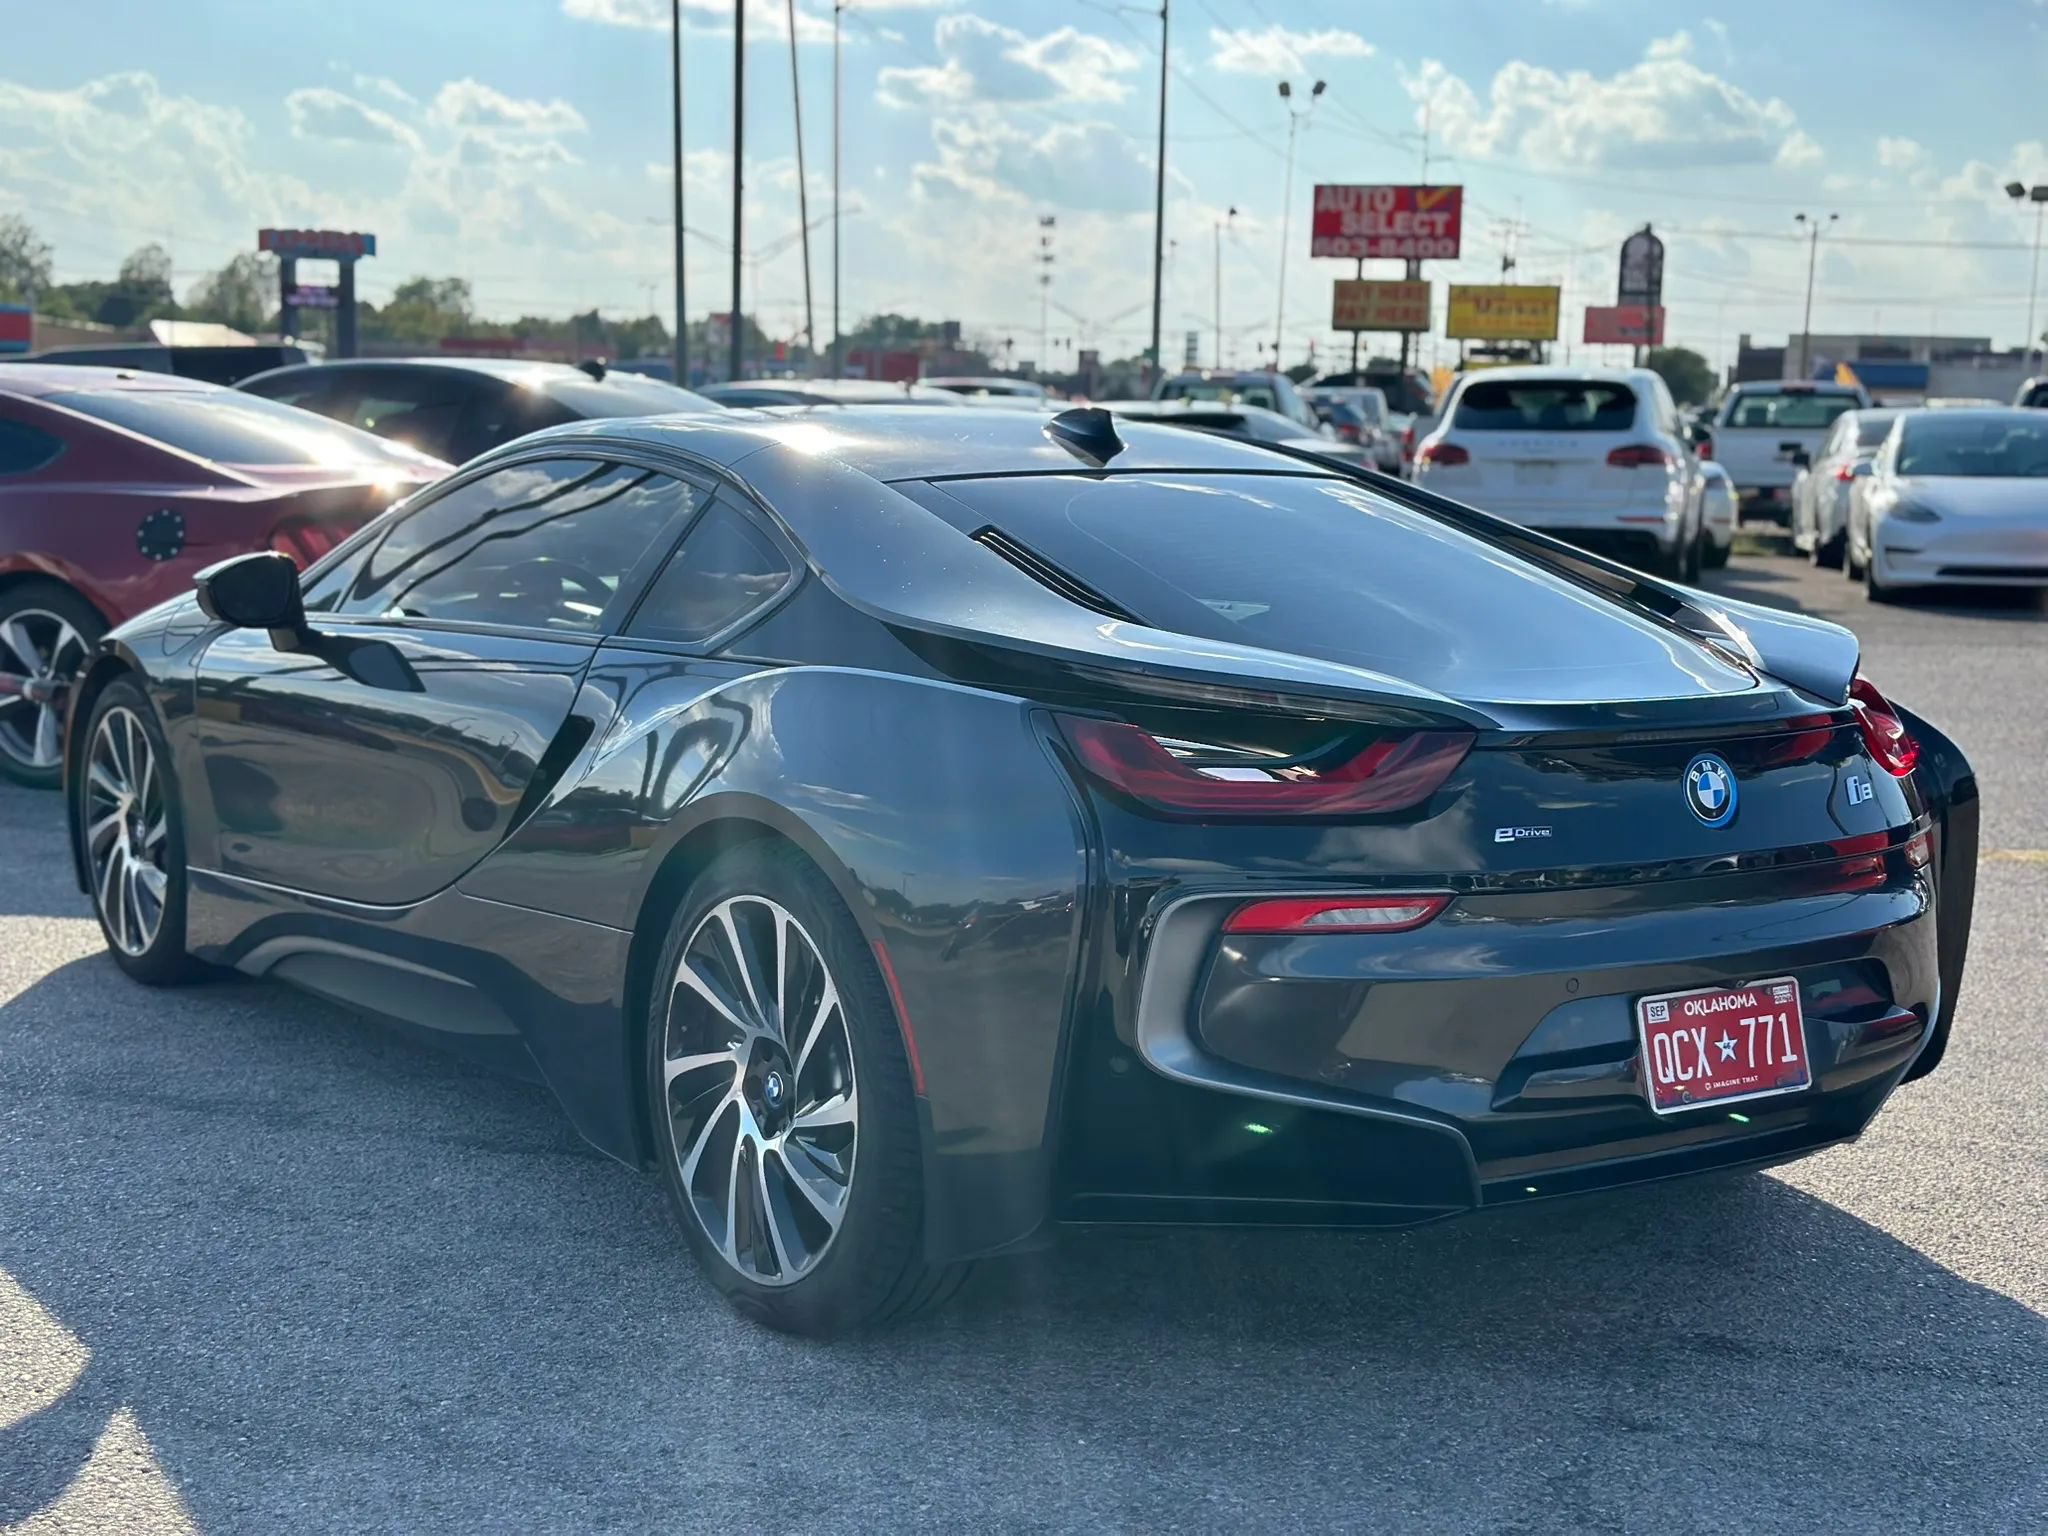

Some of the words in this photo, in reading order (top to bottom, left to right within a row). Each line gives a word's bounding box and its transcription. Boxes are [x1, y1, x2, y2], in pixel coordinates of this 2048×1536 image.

[1318, 186, 1395, 212] AUTO
[1341, 211, 1452, 236] SELECT
[1690, 762, 1727, 782] BMW
[1650, 1005, 1666, 1018] SEP
[1684, 992, 1758, 1017] OKLAHOMA
